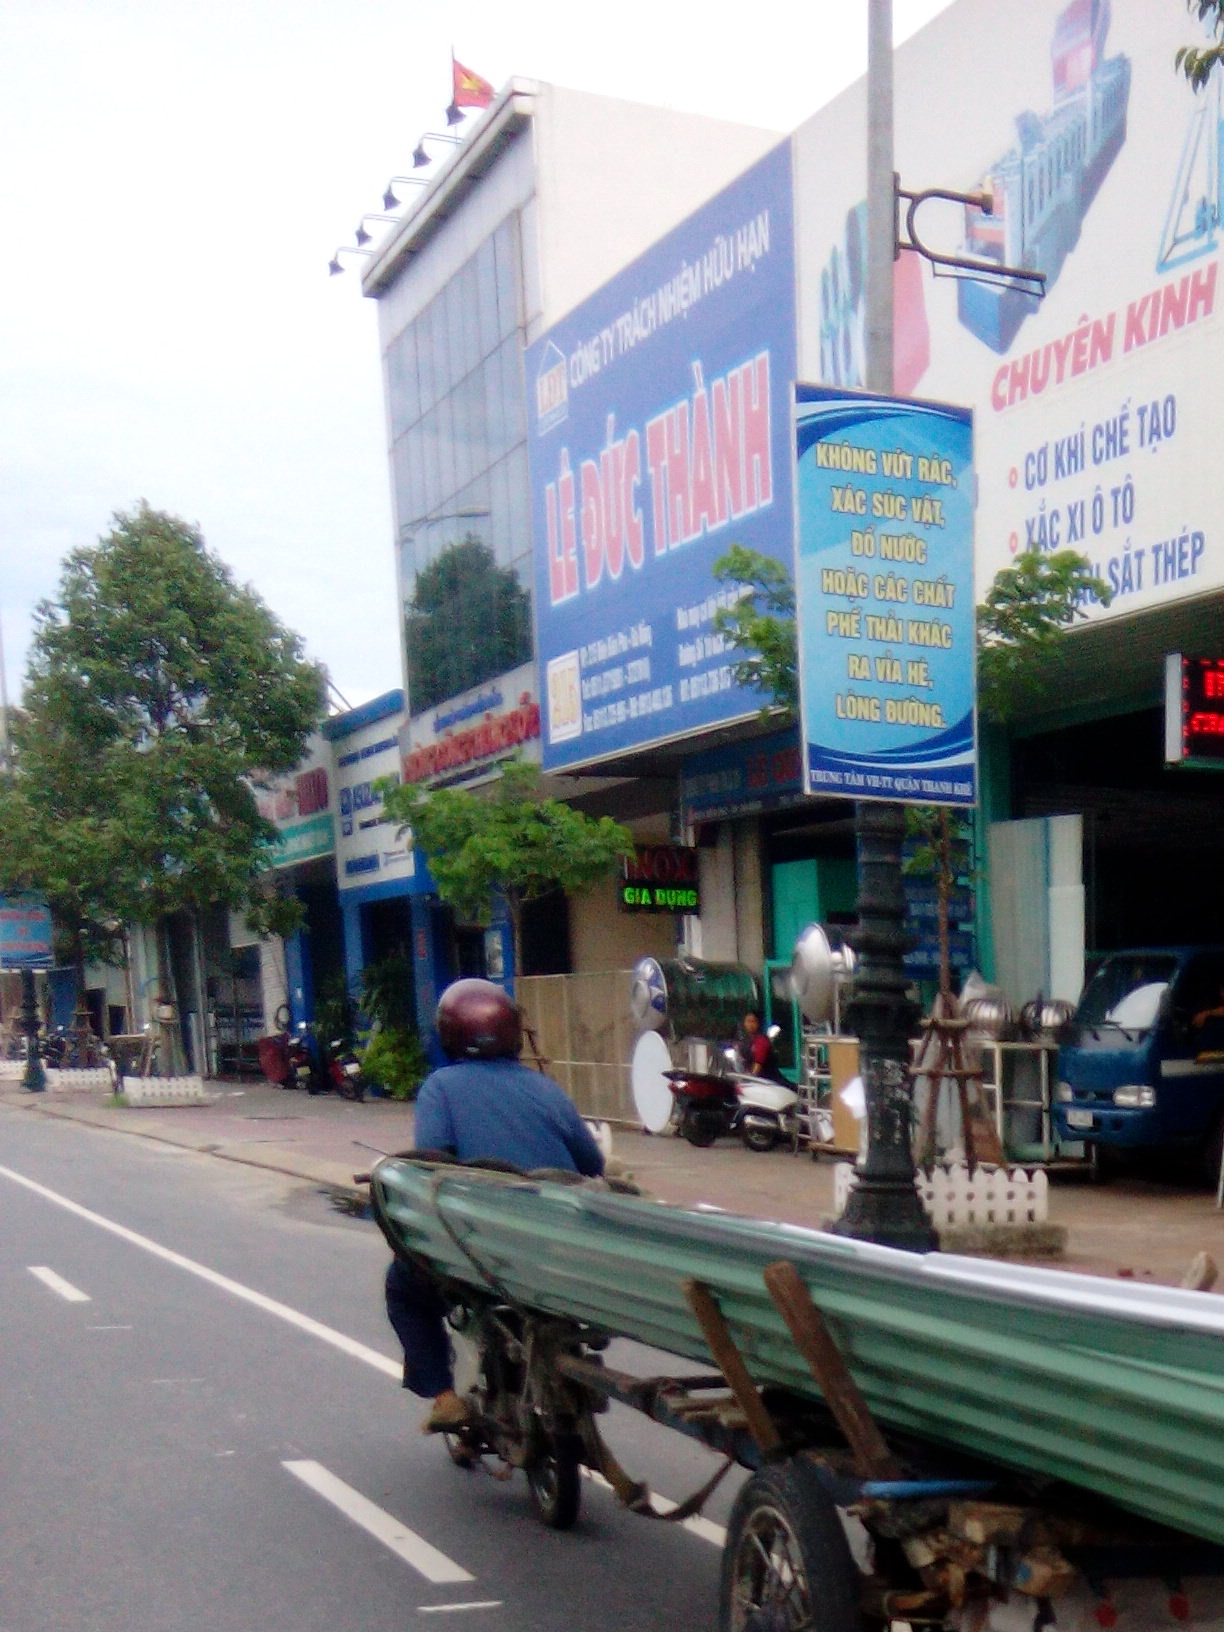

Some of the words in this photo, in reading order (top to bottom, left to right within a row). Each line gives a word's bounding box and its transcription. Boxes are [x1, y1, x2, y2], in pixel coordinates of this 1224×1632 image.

[570, 341, 601, 389] CÔNG
[616, 296, 657, 355] TRÁCH
[657, 259, 702, 326] NHIỆM
[737, 208, 770, 273] HẠN
[991, 312, 1116, 413] CHUYÊN
[1123, 260, 1219, 353] KINH
[816, 440, 878, 476] KHÔNG
[881, 447, 914, 481] VỨT
[918, 453, 958, 489] RÁC,
[1025, 441, 1049, 491] CƠ
[1054, 421, 1086, 481] KHÍ
[1092, 397, 1132, 466] CHẾ
[1136, 394, 1177, 454] TẠO
[546, 446, 580, 607] LÊ
[580, 411, 646, 590] ĐỨC
[646, 347, 774, 557] THÀNH
[831, 482, 867, 515] XÁC
[871, 488, 908, 521] SÚC
[1067, 500, 1085, 544] XI
[1092, 485, 1105, 536] Ô
[1110, 473, 1135, 528] TÔ
[879, 532, 928, 565] NƯỚC
[1108, 536, 1146, 596] SẮT
[1152, 525, 1205, 585] THÉP
[822, 565, 869, 603] HOẶC
[873, 571, 908, 604] CÁC
[912, 575, 956, 609] CHẤT
[826, 606, 862, 639] PHẾ
[865, 610, 904, 643] THẢI
[908, 618, 953, 650] KHÁC
[848, 653, 871, 680] RA
[835, 688, 881, 723] LÒNG
[810, 769, 845, 784] TRUNG
[624, 887, 653, 906] GIA
